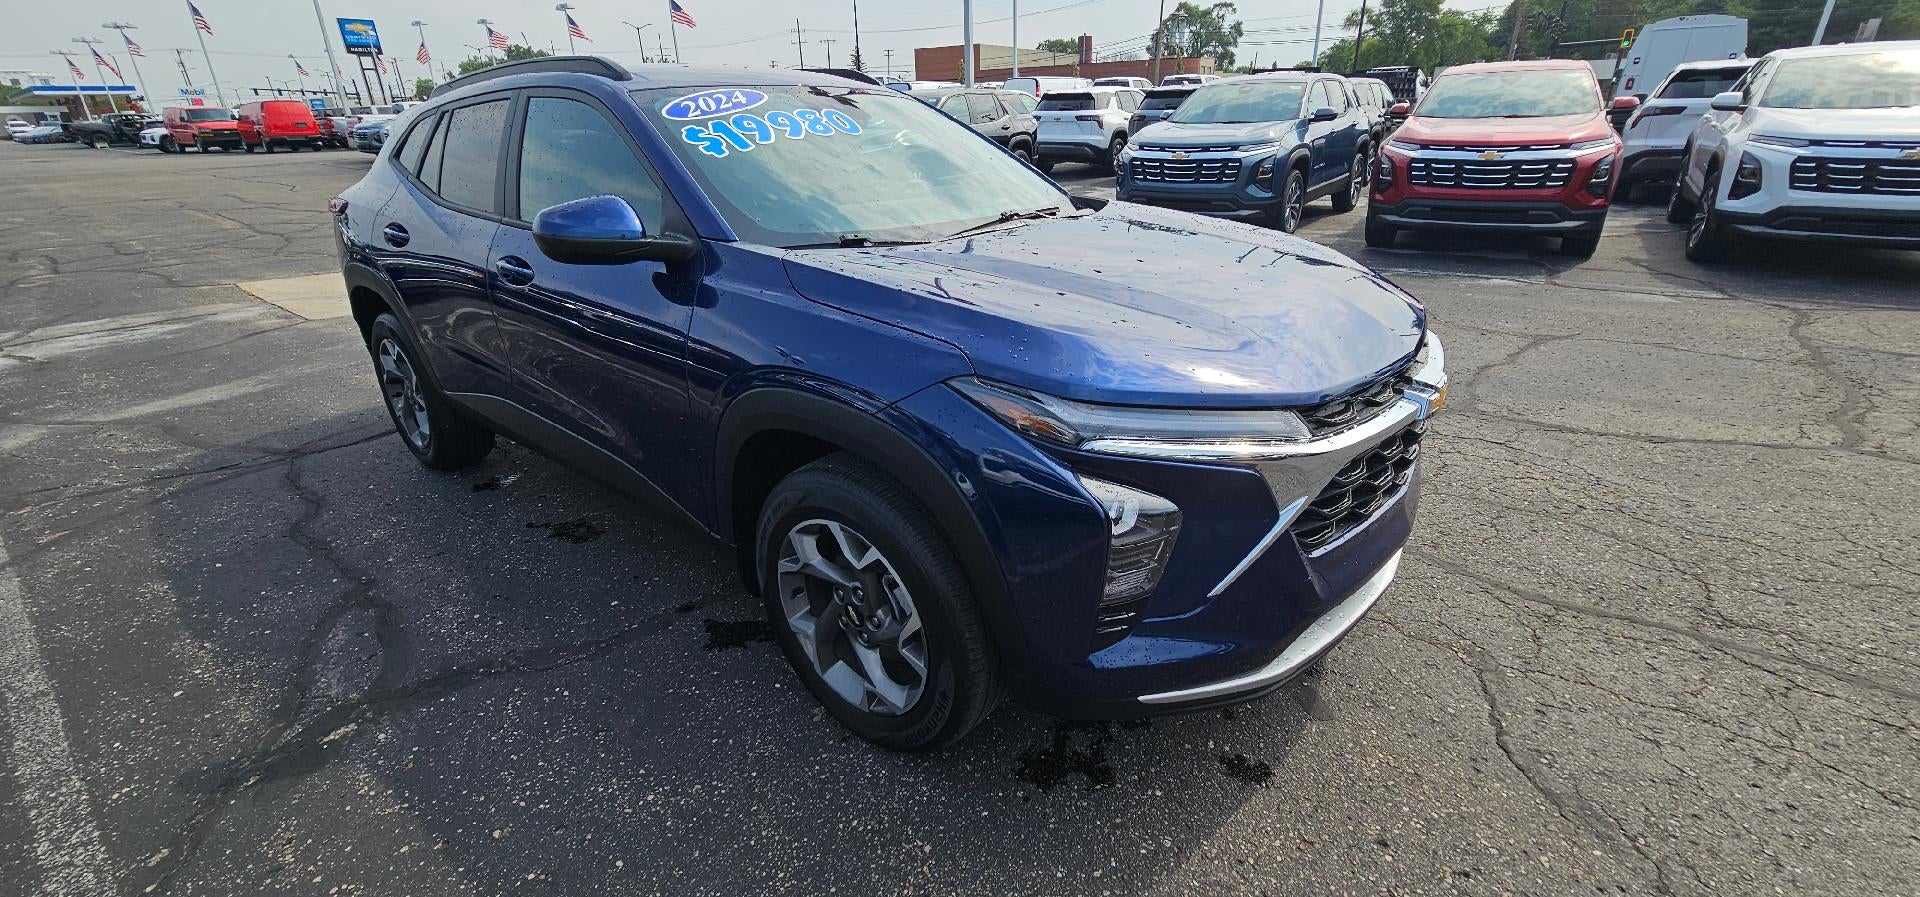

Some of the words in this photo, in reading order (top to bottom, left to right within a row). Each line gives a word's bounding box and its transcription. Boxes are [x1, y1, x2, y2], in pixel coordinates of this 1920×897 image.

[180, 88, 206, 96] Mobil
[680, 90, 747, 118] 2024
[682, 109, 863, 158] $19980
